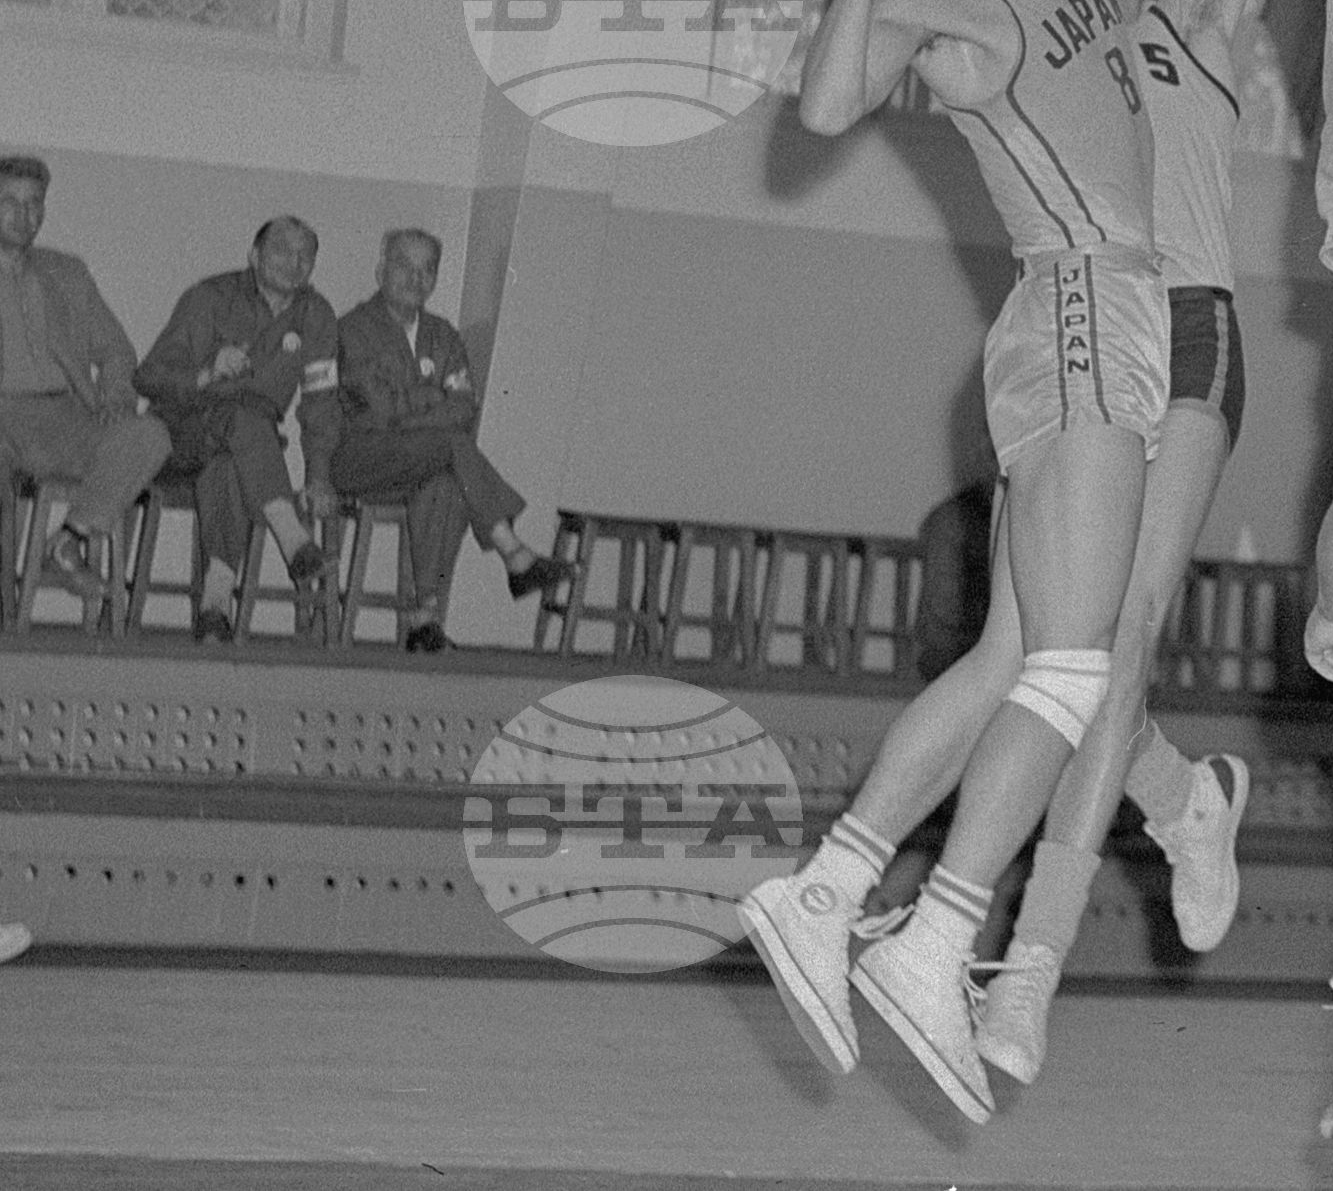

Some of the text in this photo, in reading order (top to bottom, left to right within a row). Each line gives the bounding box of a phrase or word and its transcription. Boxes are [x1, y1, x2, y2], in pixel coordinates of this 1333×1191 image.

[1104, 46, 1141, 115] 8
[1139, 42, 1180, 87] 5
[1062, 268, 1090, 374] JAPAN
